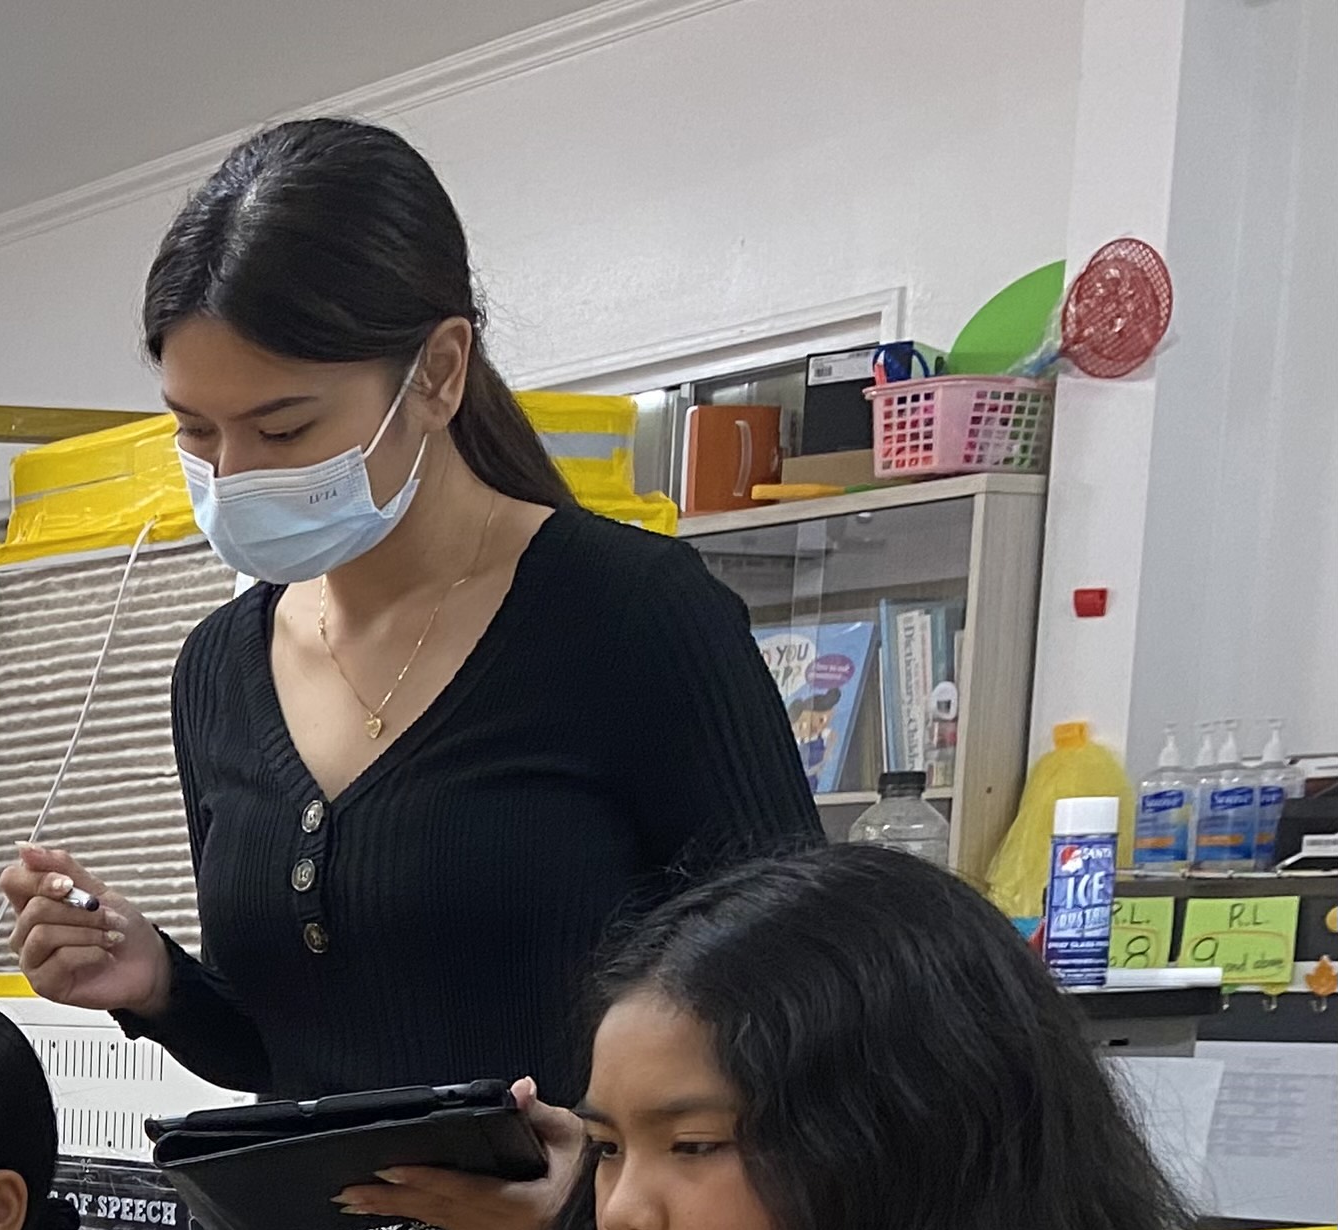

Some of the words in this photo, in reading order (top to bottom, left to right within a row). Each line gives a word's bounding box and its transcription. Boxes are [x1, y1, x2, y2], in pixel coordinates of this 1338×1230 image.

[1066, 870, 1106, 909] ICE
[1192, 936, 1220, 961] 9
[97, 1195, 177, 1226] SPEECH
